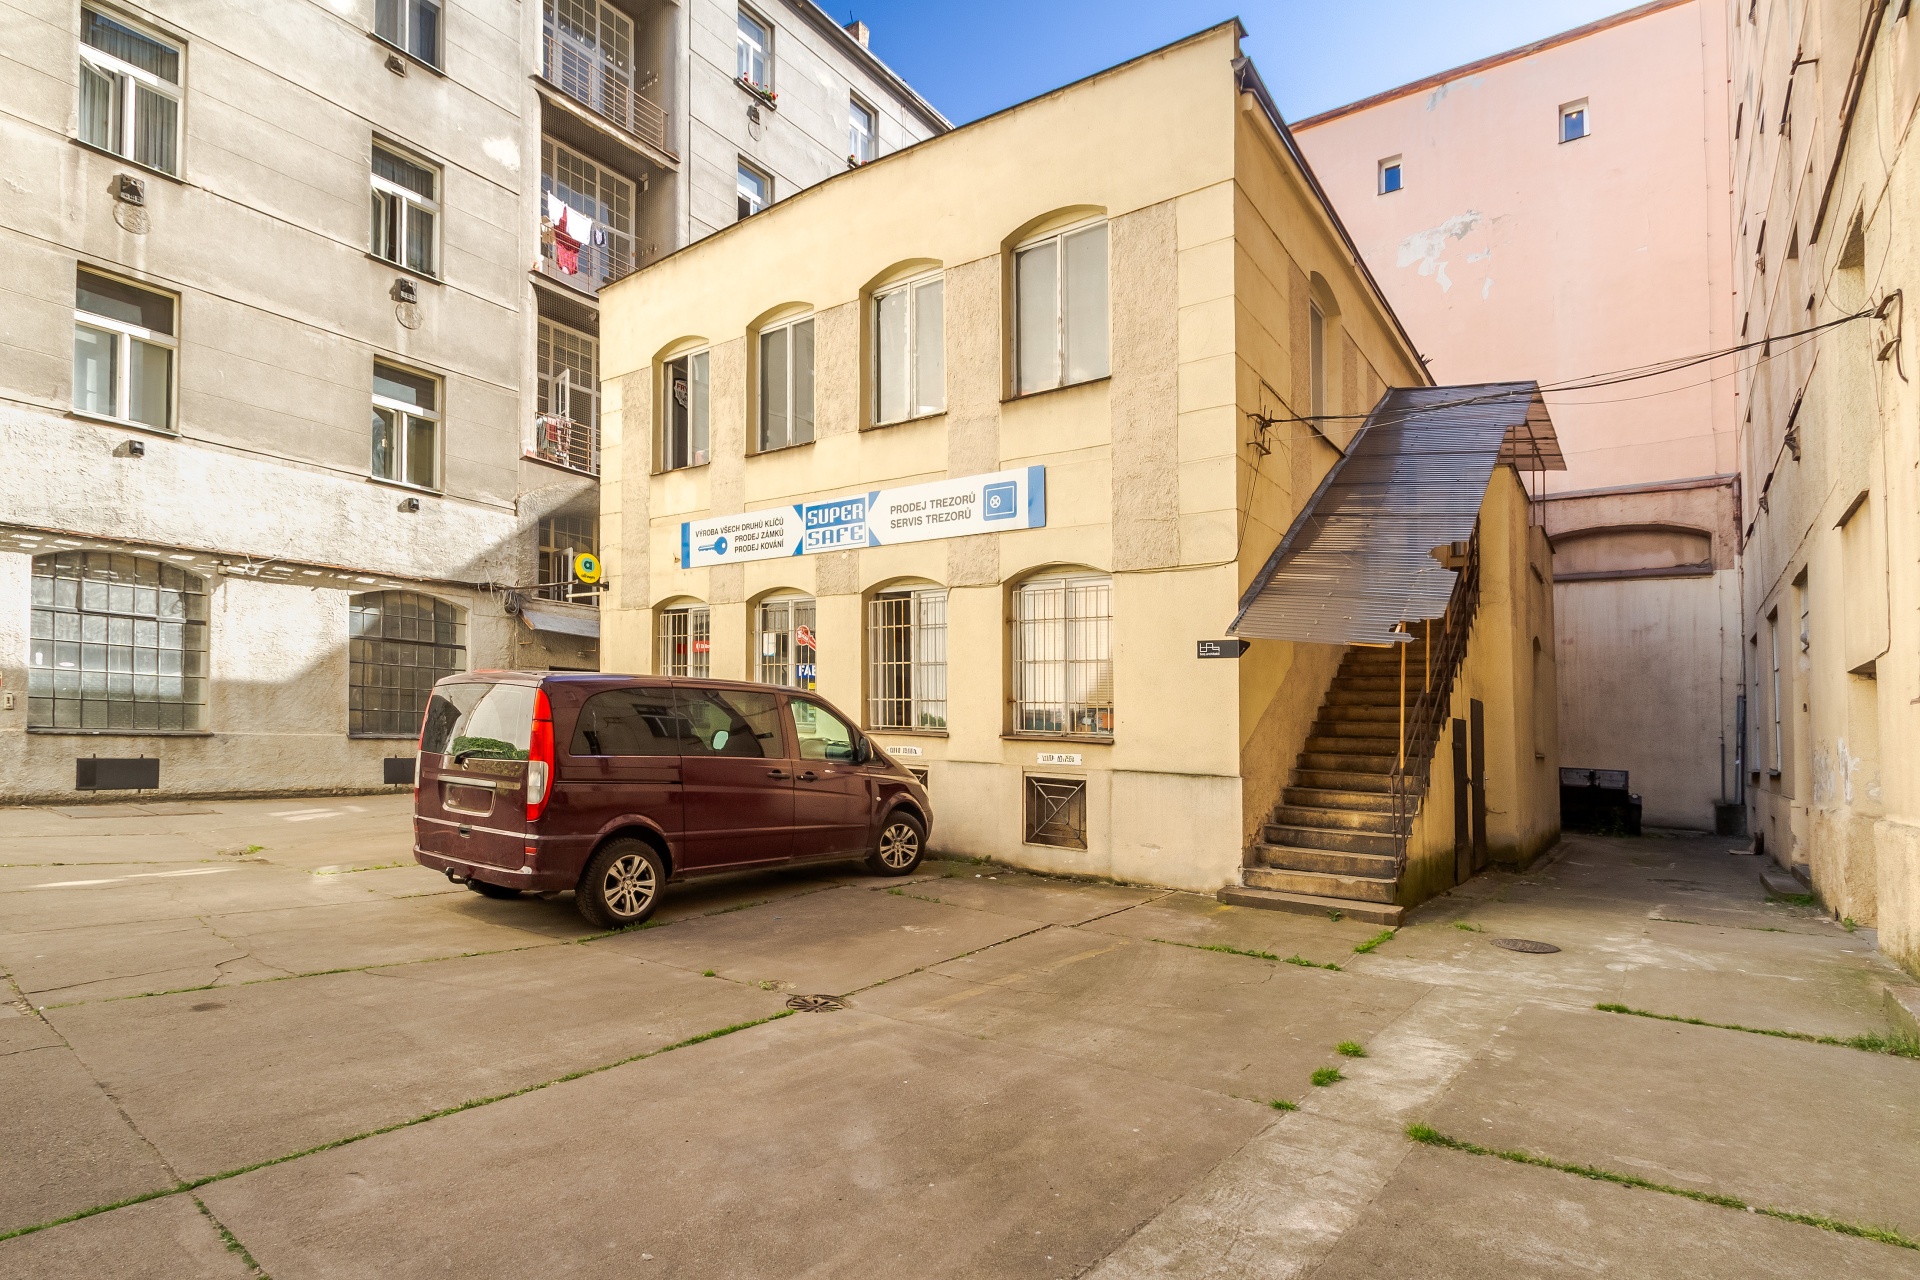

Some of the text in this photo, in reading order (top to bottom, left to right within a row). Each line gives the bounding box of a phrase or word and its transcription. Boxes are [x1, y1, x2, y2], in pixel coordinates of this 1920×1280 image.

[890, 491, 976, 515] PRODEJ TREZORŮ
[807, 503, 864, 527] SUPER
[890, 507, 972, 529] SERVIS TREZORŮ
[695, 516, 784, 538] VÝROBA VŠECH DRUHŮ KLÍČŮ
[734, 527, 784, 543] PRODEJ ZÁMKŮ
[808, 525, 864, 547] SAFE
[734, 538, 784, 554] PRODEJ KOVÁNÍ
